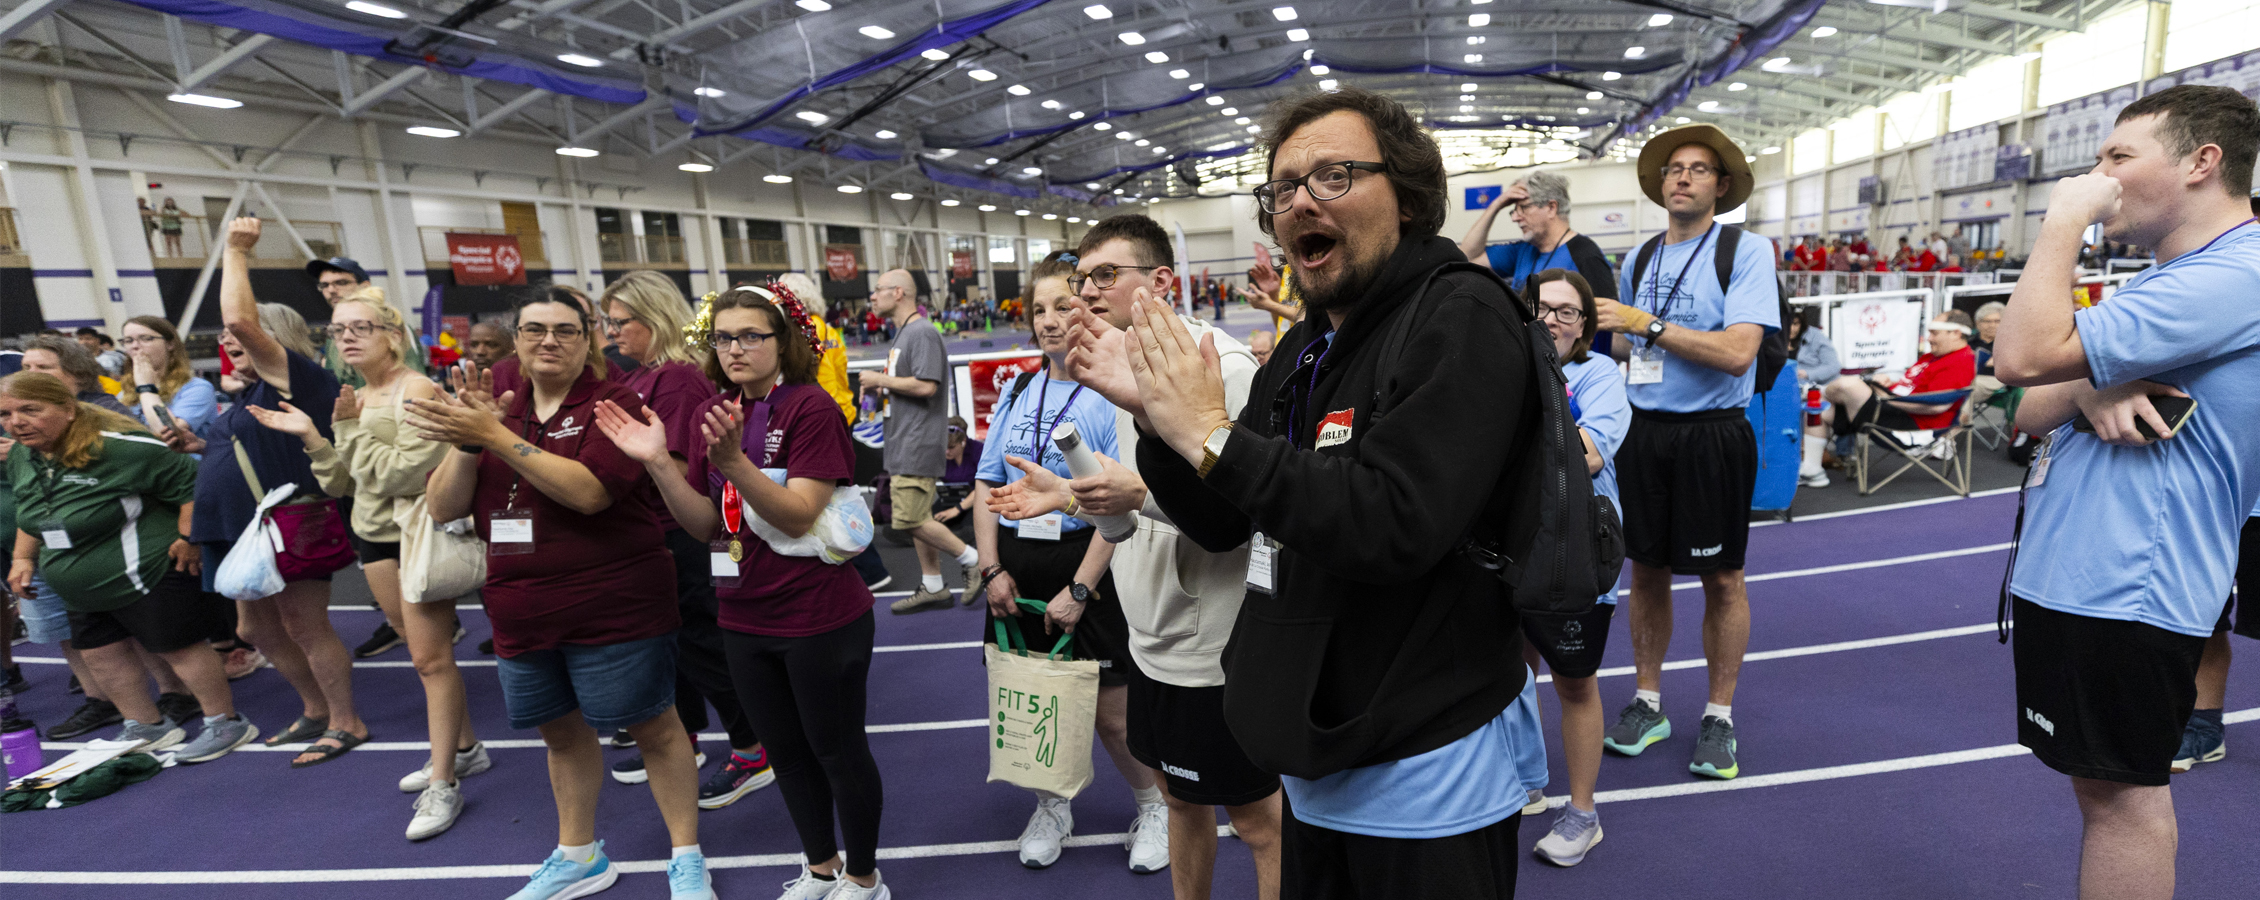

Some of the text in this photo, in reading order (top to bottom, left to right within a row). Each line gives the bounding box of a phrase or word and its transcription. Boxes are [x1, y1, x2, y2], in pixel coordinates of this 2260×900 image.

[1855, 340, 1890, 349] Special
[1852, 350, 1895, 359] Olympics
[1043, 410, 1076, 424] Crsse
[1004, 440, 1034, 456] Special
[998, 687, 1040, 714] FIT 5
[1160, 760, 1200, 782] LA CROSSE
